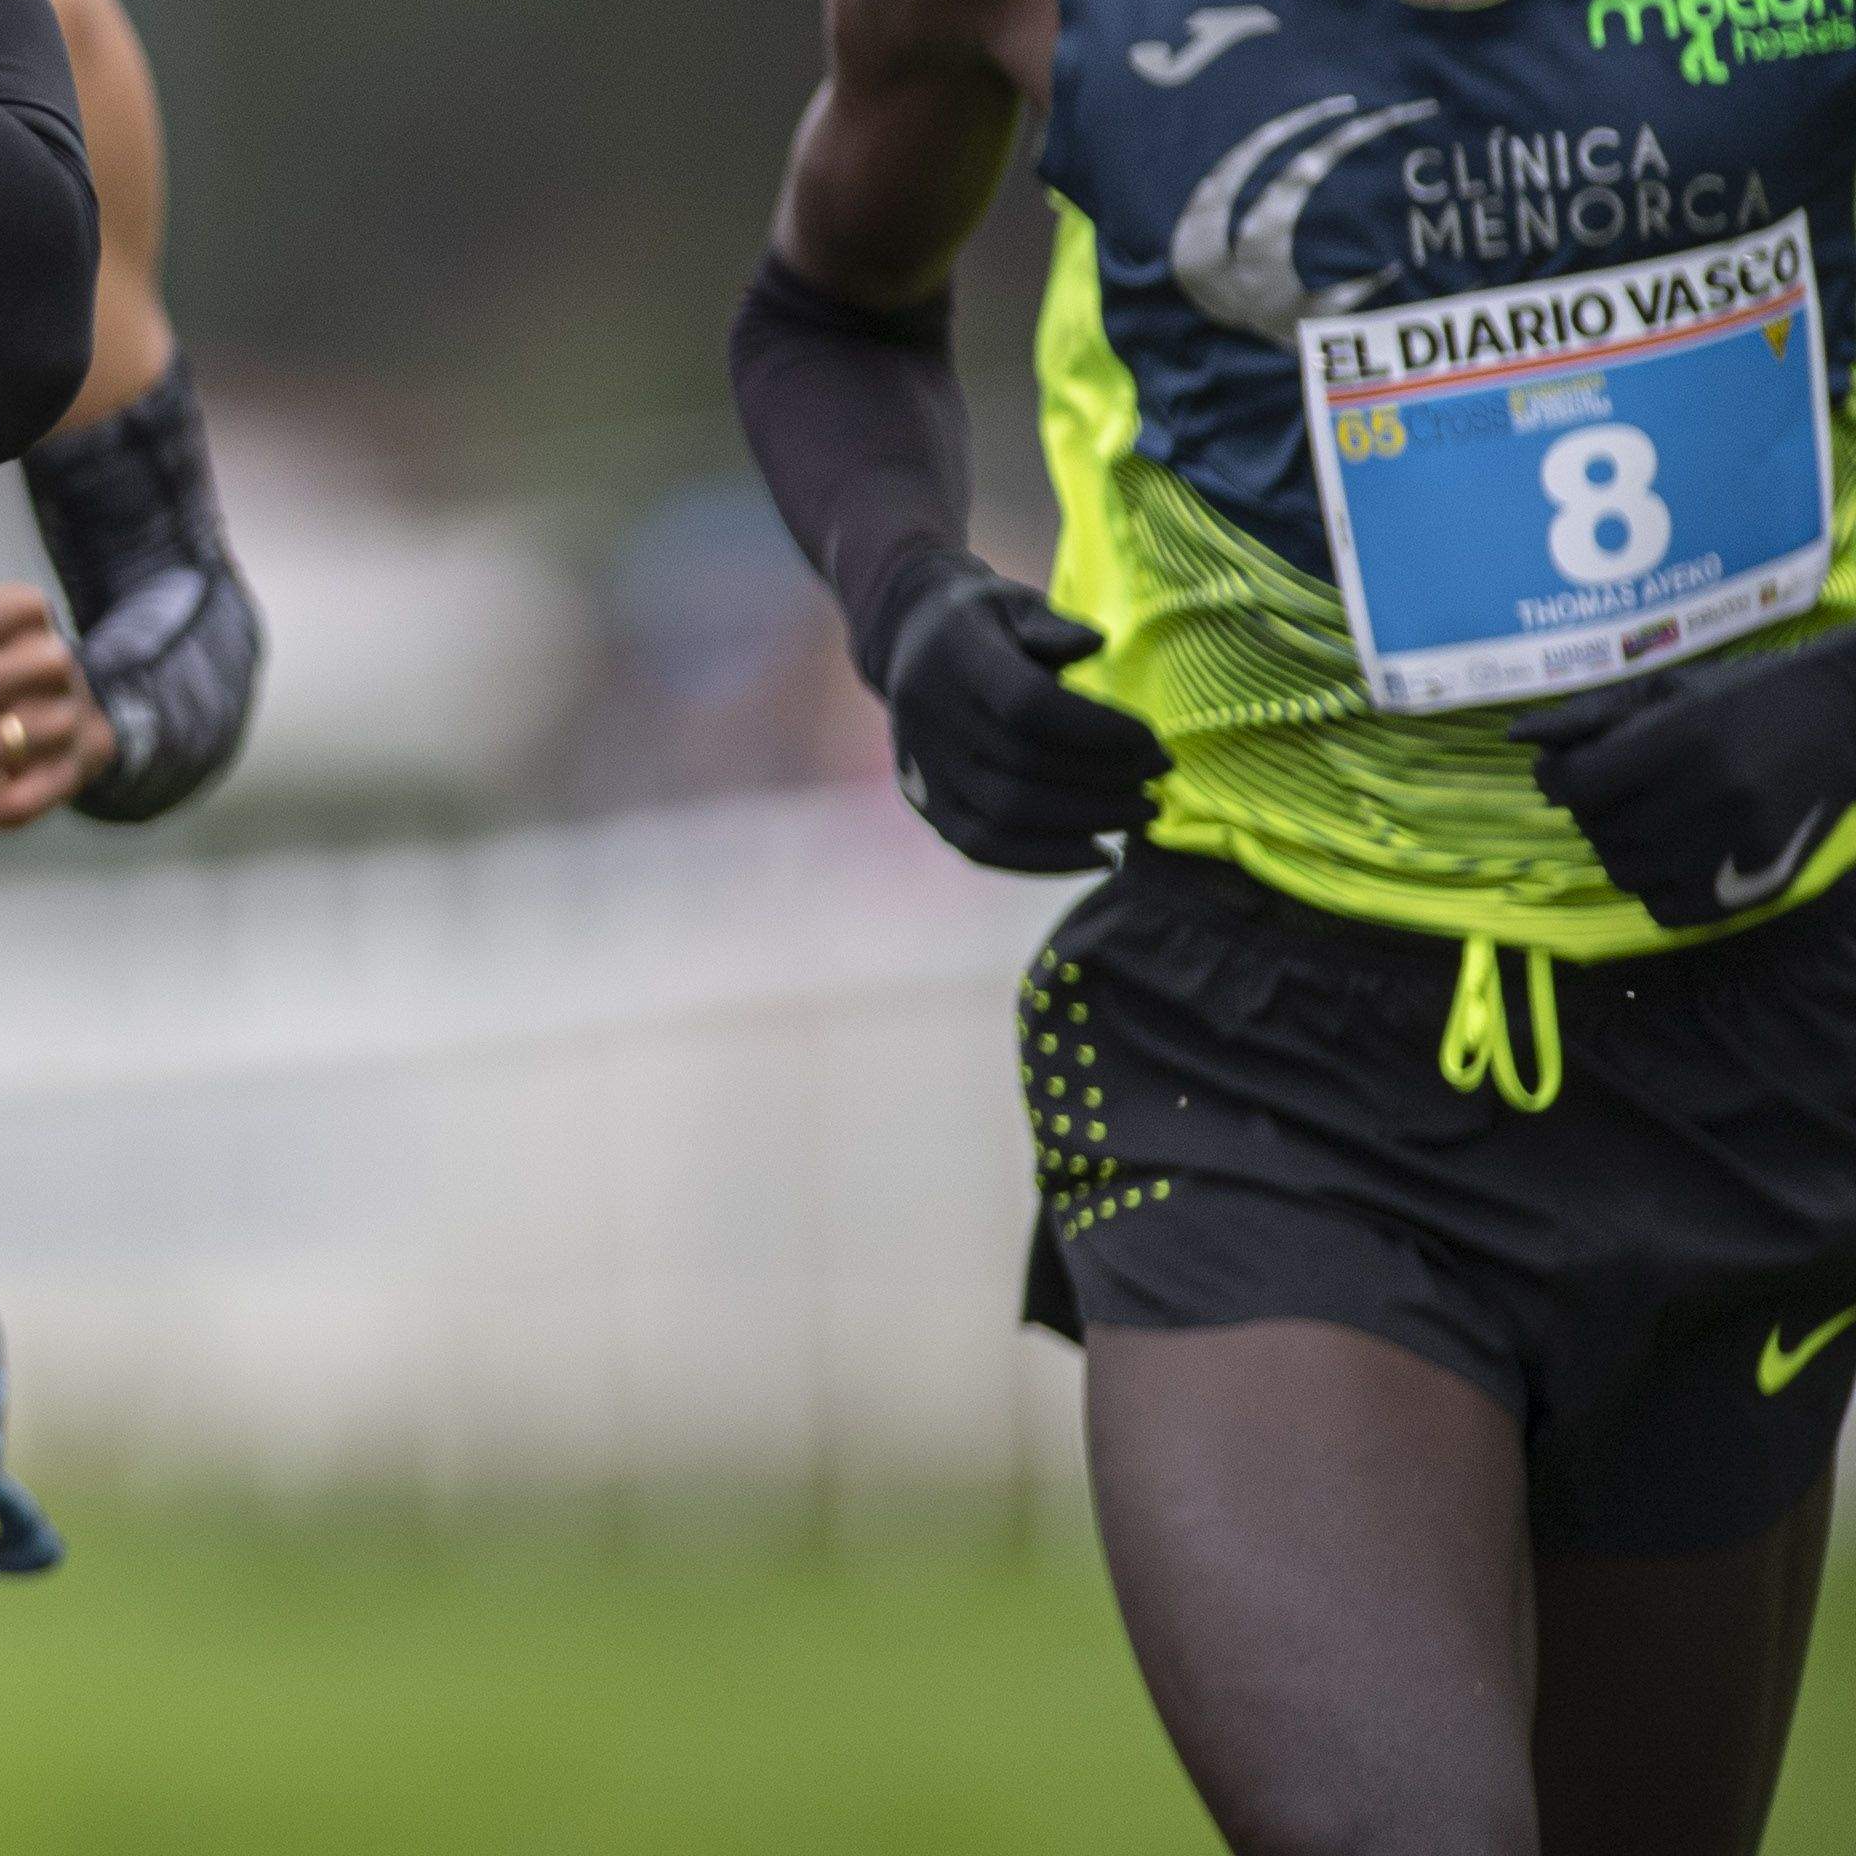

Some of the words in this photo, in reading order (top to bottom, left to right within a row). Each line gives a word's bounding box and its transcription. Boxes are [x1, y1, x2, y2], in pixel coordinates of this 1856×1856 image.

[1408, 169, 1772, 268] MENORCA
[1320, 331, 1391, 385] EL
[1399, 292, 1617, 370] DIARIO
[1629, 238, 1801, 324] VASCO
[1336, 404, 1407, 463] 65
[1539, 423, 1673, 584] 8
